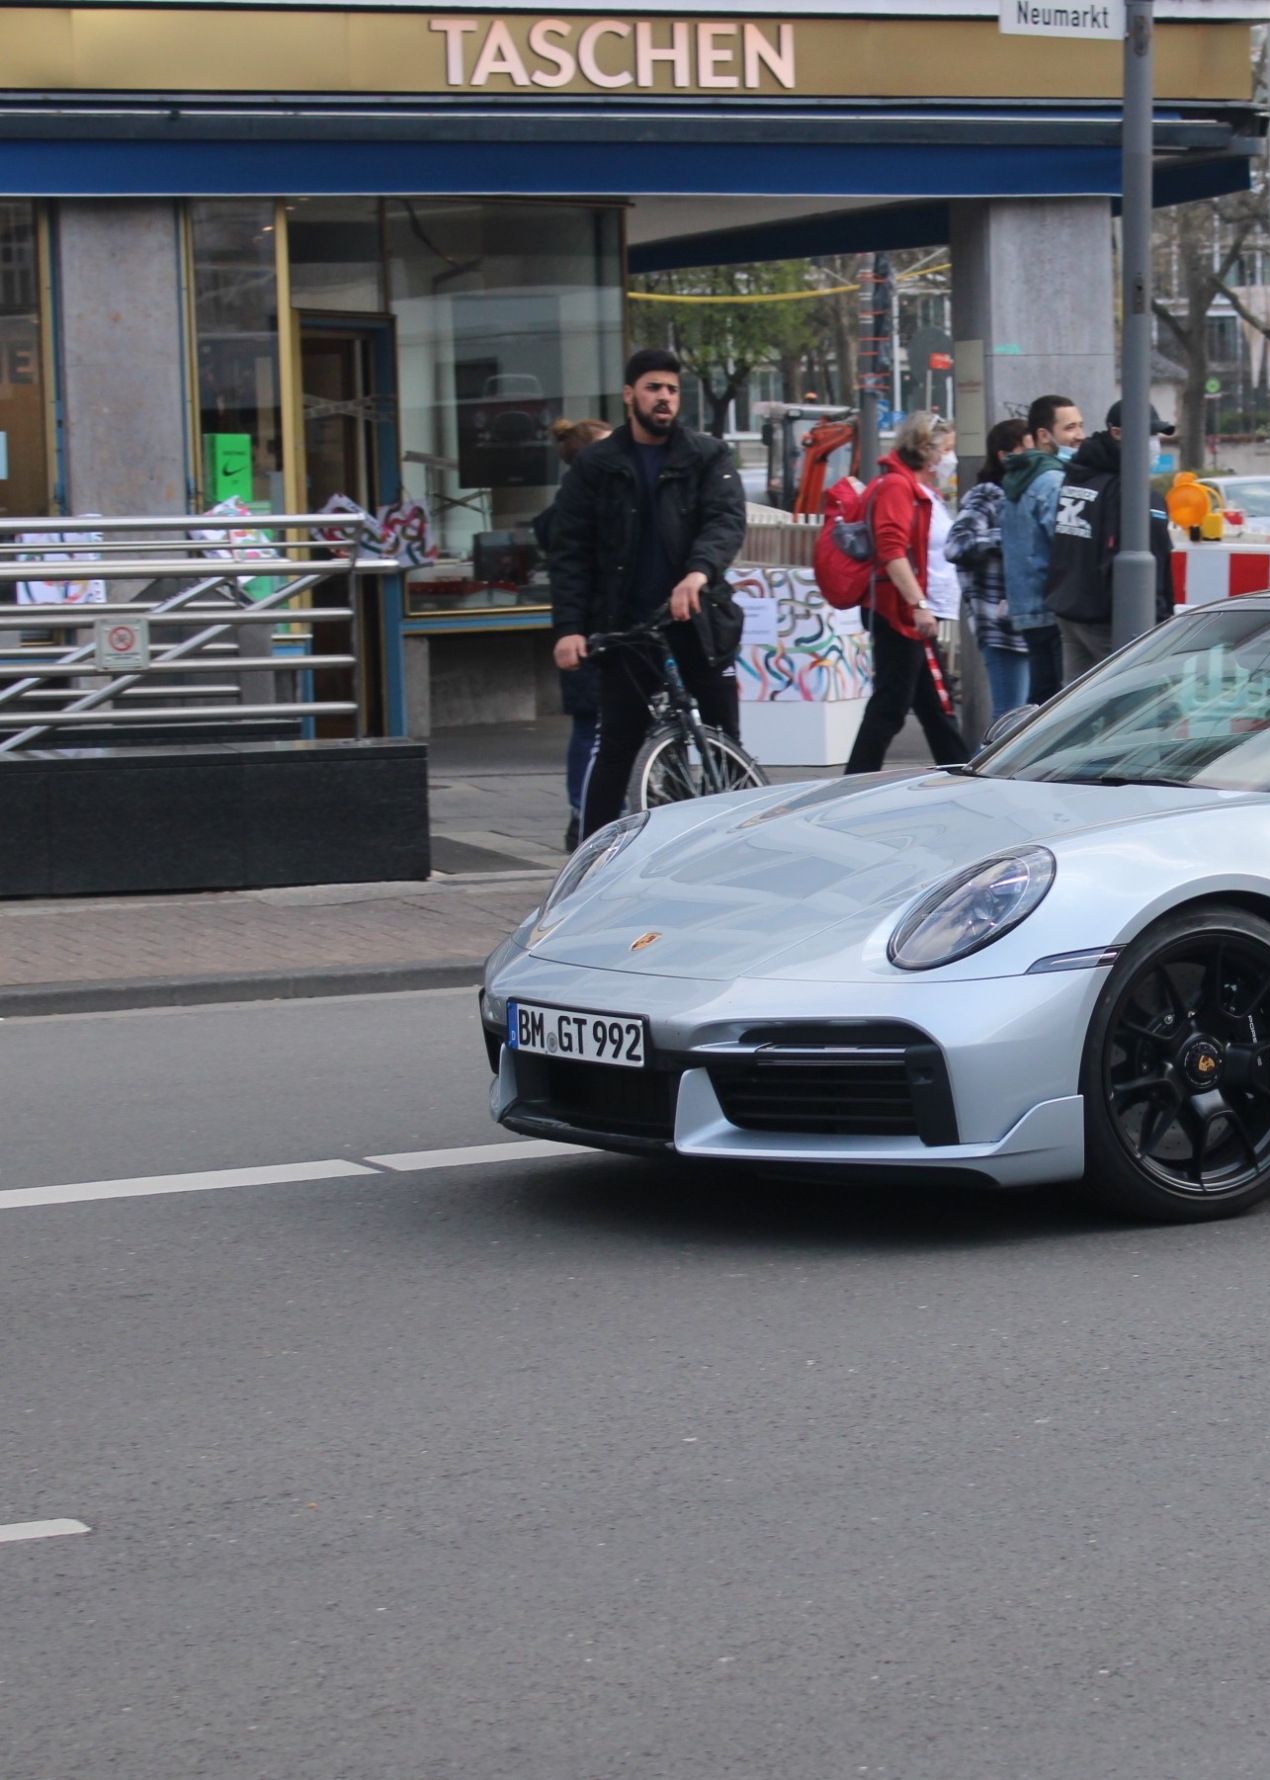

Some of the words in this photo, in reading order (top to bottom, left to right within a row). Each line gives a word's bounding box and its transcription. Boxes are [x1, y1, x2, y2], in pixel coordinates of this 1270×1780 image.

[1016, 1, 1110, 29] Neumarkt
[429, 19, 796, 88] TASCHEN
[518, 1009, 545, 1049] BM
[558, 1015, 587, 1055] GT
[592, 1020, 642, 1062] 992
